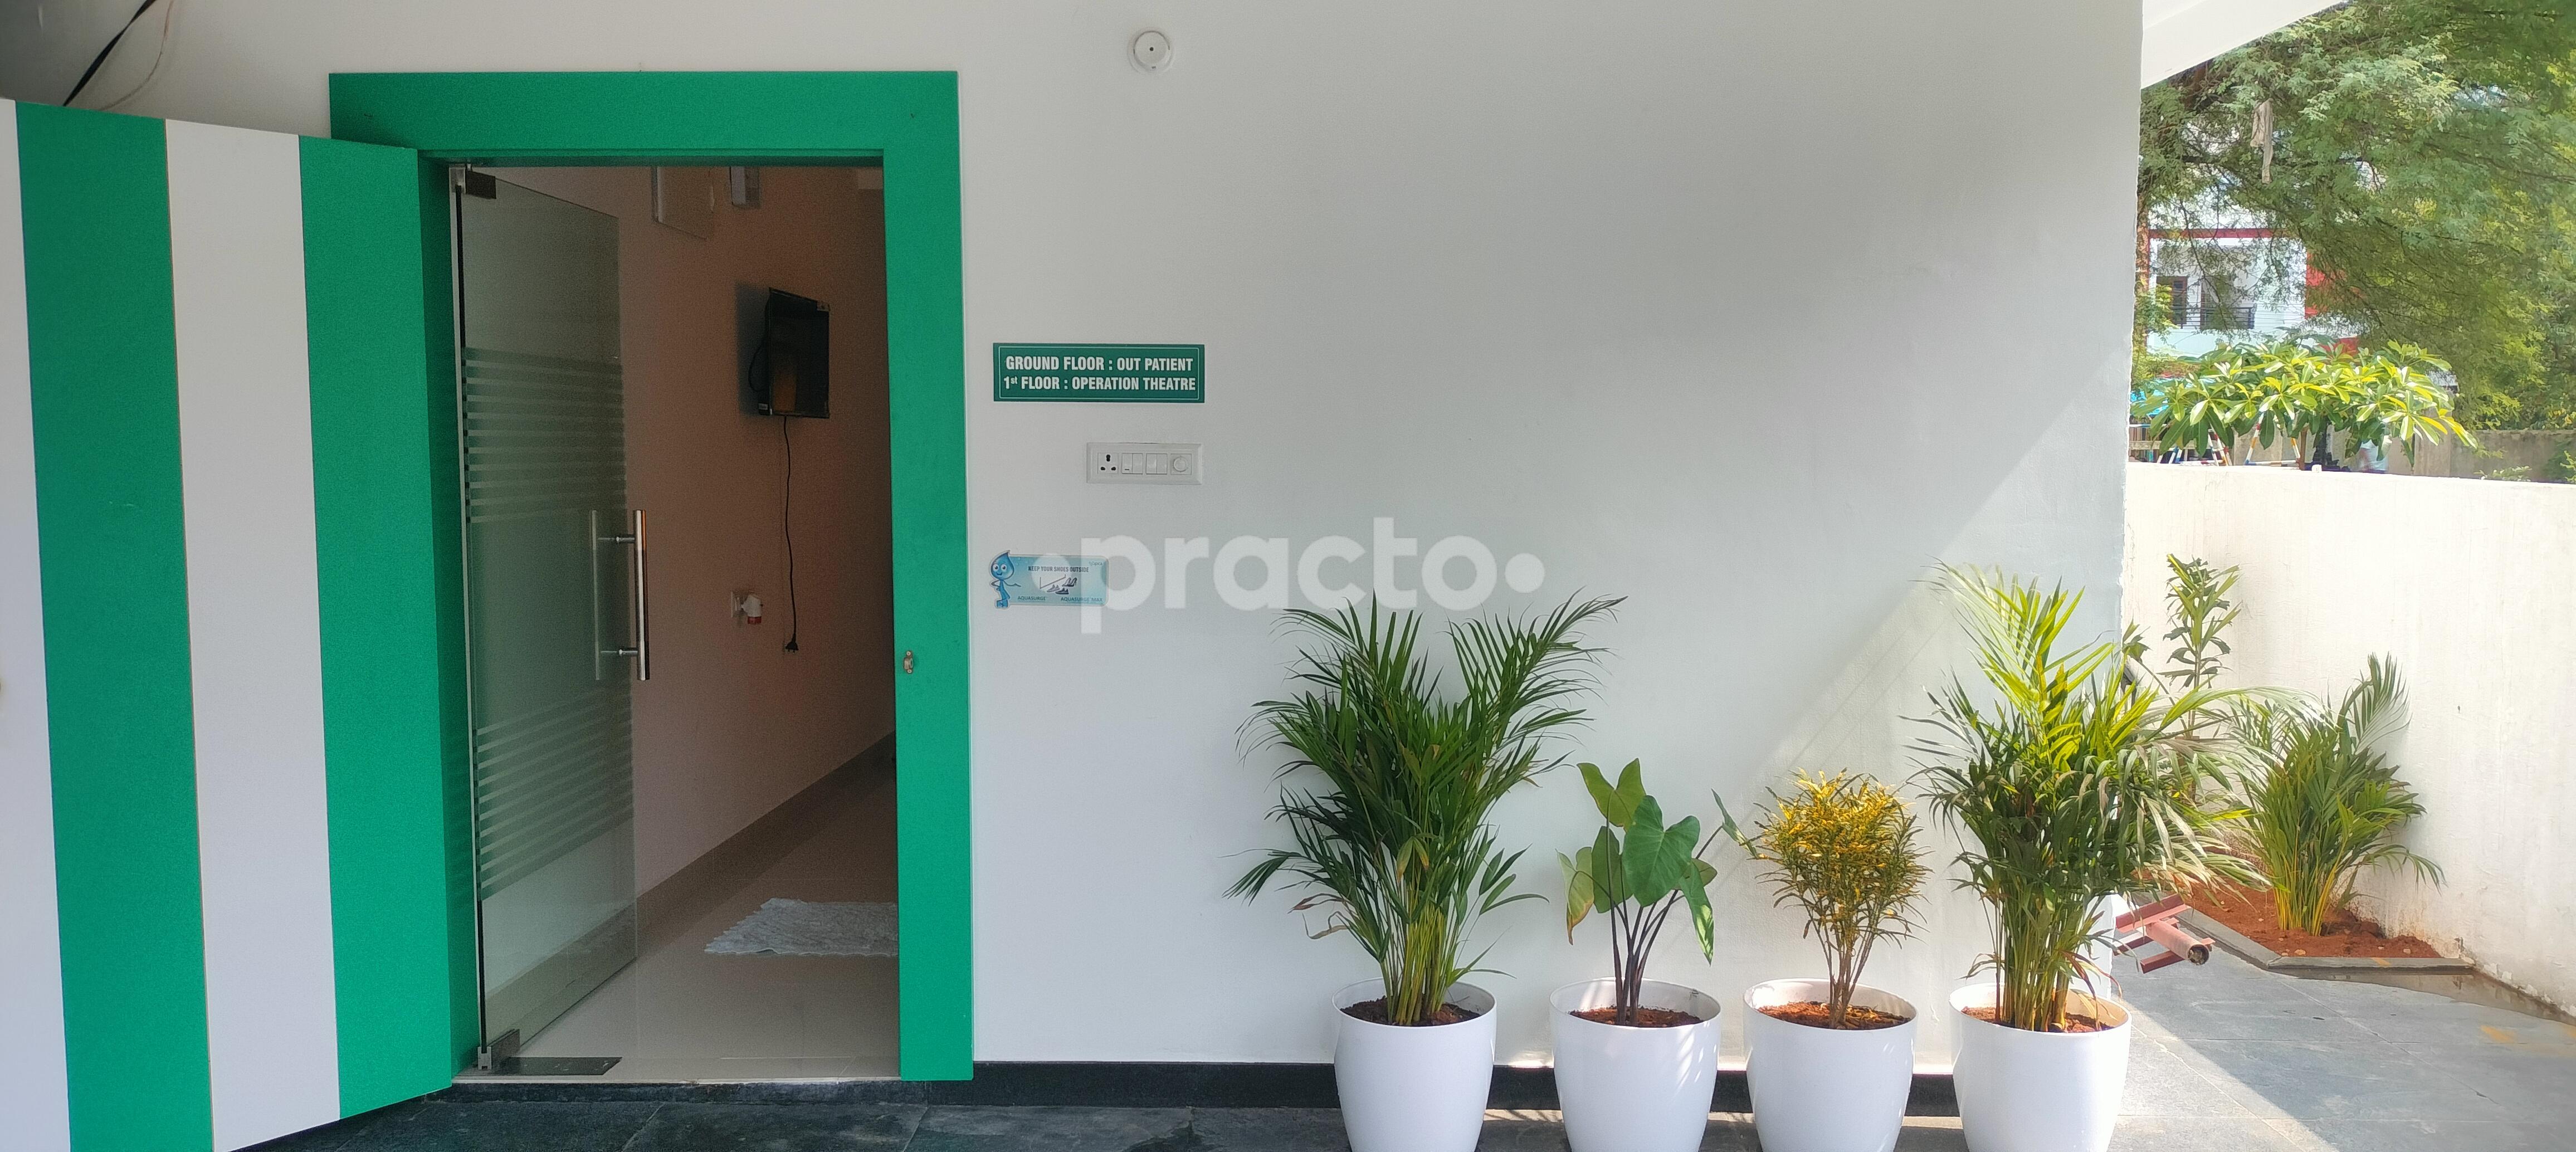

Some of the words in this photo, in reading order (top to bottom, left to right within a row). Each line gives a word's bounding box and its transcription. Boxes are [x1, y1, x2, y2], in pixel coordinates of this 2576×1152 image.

[1006, 356, 1059, 370] GROUND
[1063, 357, 1105, 370] FLOOR
[1109, 360, 1113, 370] :
[1117, 358, 1141, 370] OUT
[1145, 358, 1193, 371] PATIENT
[1004, 376, 1018, 389] 1st
[1021, 376, 1060, 389] FLOOR
[1064, 379, 1068, 389] :
[1072, 377, 1139, 390] OPERATION
[1143, 377, 1196, 390] THEATRE
